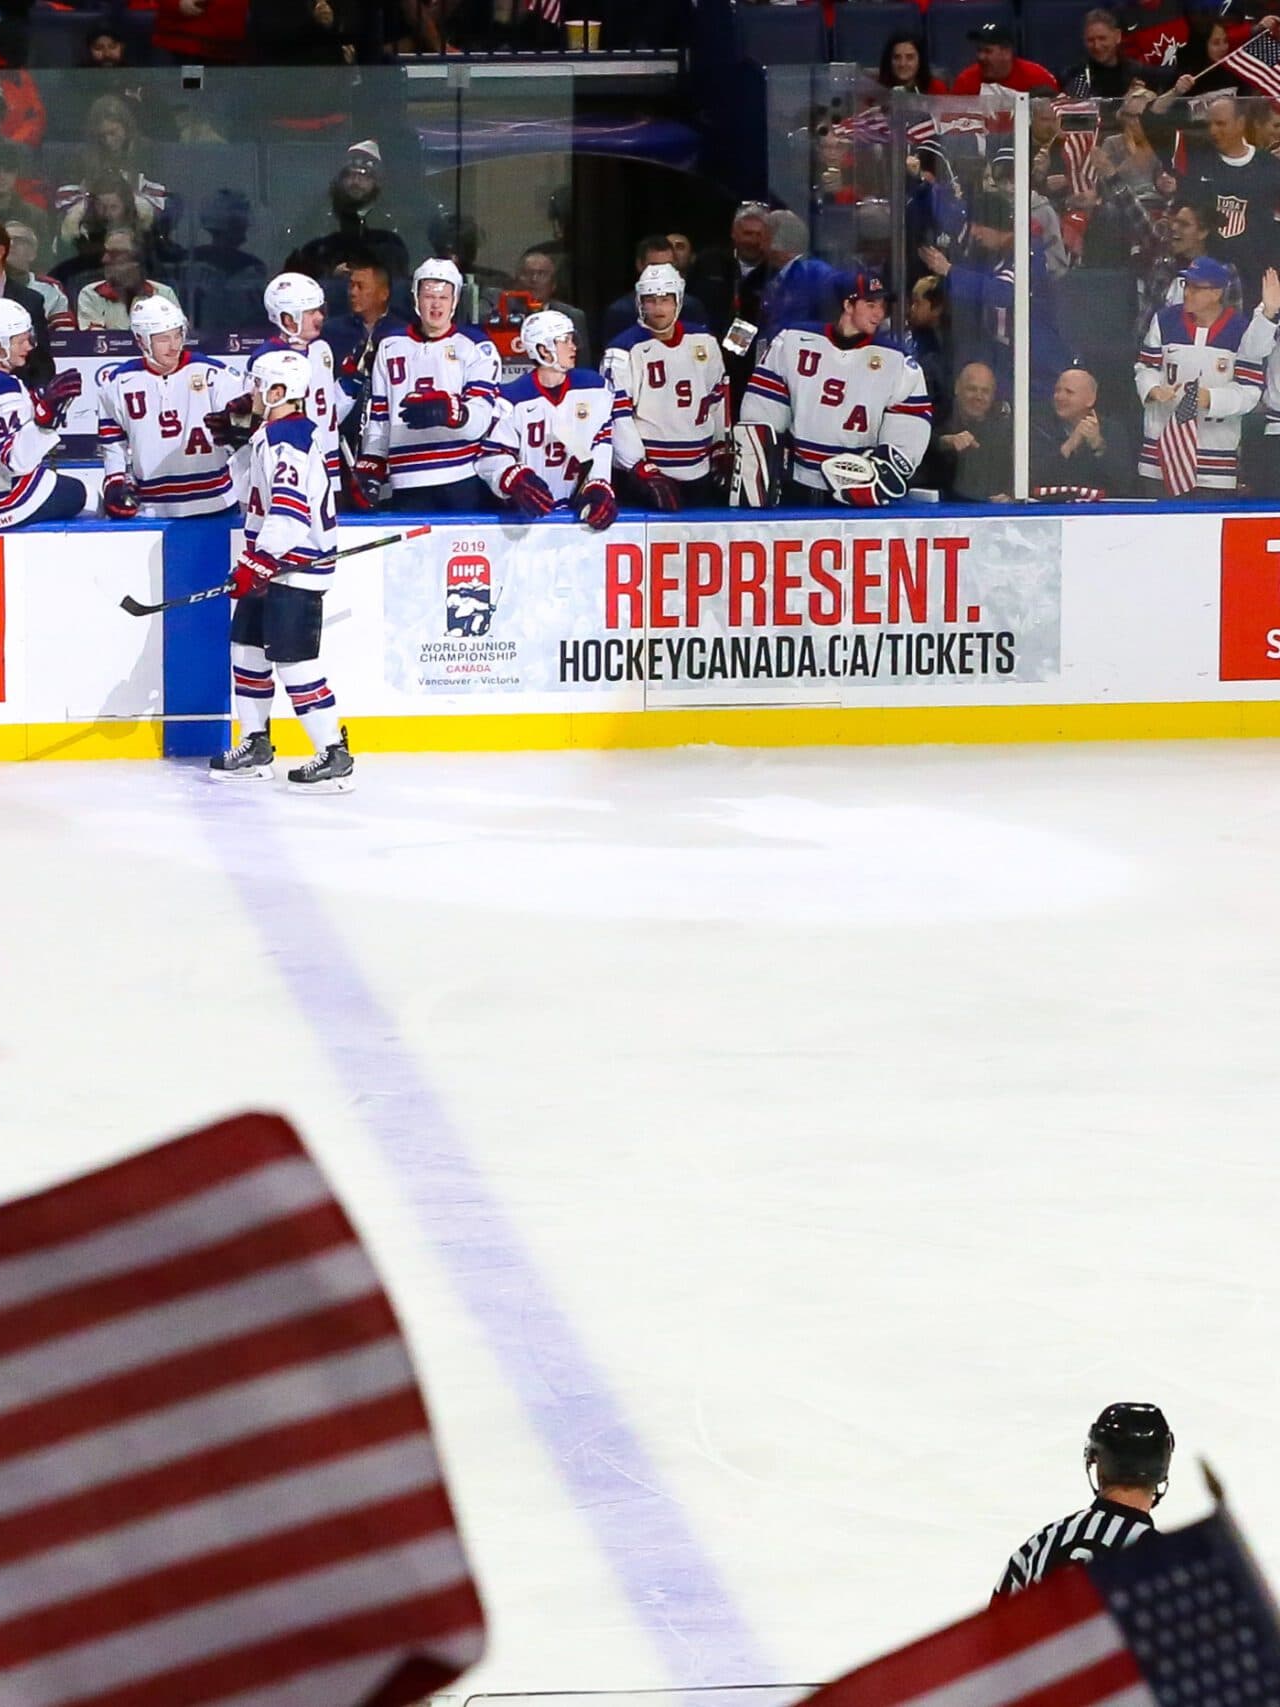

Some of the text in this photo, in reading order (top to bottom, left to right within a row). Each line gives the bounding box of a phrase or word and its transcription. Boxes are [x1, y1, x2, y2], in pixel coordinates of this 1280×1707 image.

[1222, 199, 1241, 210] USA
[205, 368, 218, 387] C
[797, 349, 869, 433] USA
[124, 391, 213, 455] USA
[274, 461, 299, 487] 23
[452, 541, 485, 553] 2019
[452, 564, 485, 577] IIHF
[605, 537, 981, 629] REPRESENT.
[189, 583, 237, 603] CCM
[421, 641, 516, 653] WORLD JUNIOR
[420, 651, 517, 663] CHAMPIONSHIP
[559, 632, 1015, 682] HOCKEYCANADA.CA/TICKETS
[446, 664, 491, 673] CANADA
[418, 677, 471, 686] Vancouver
[480, 675, 520, 685] Victoria
